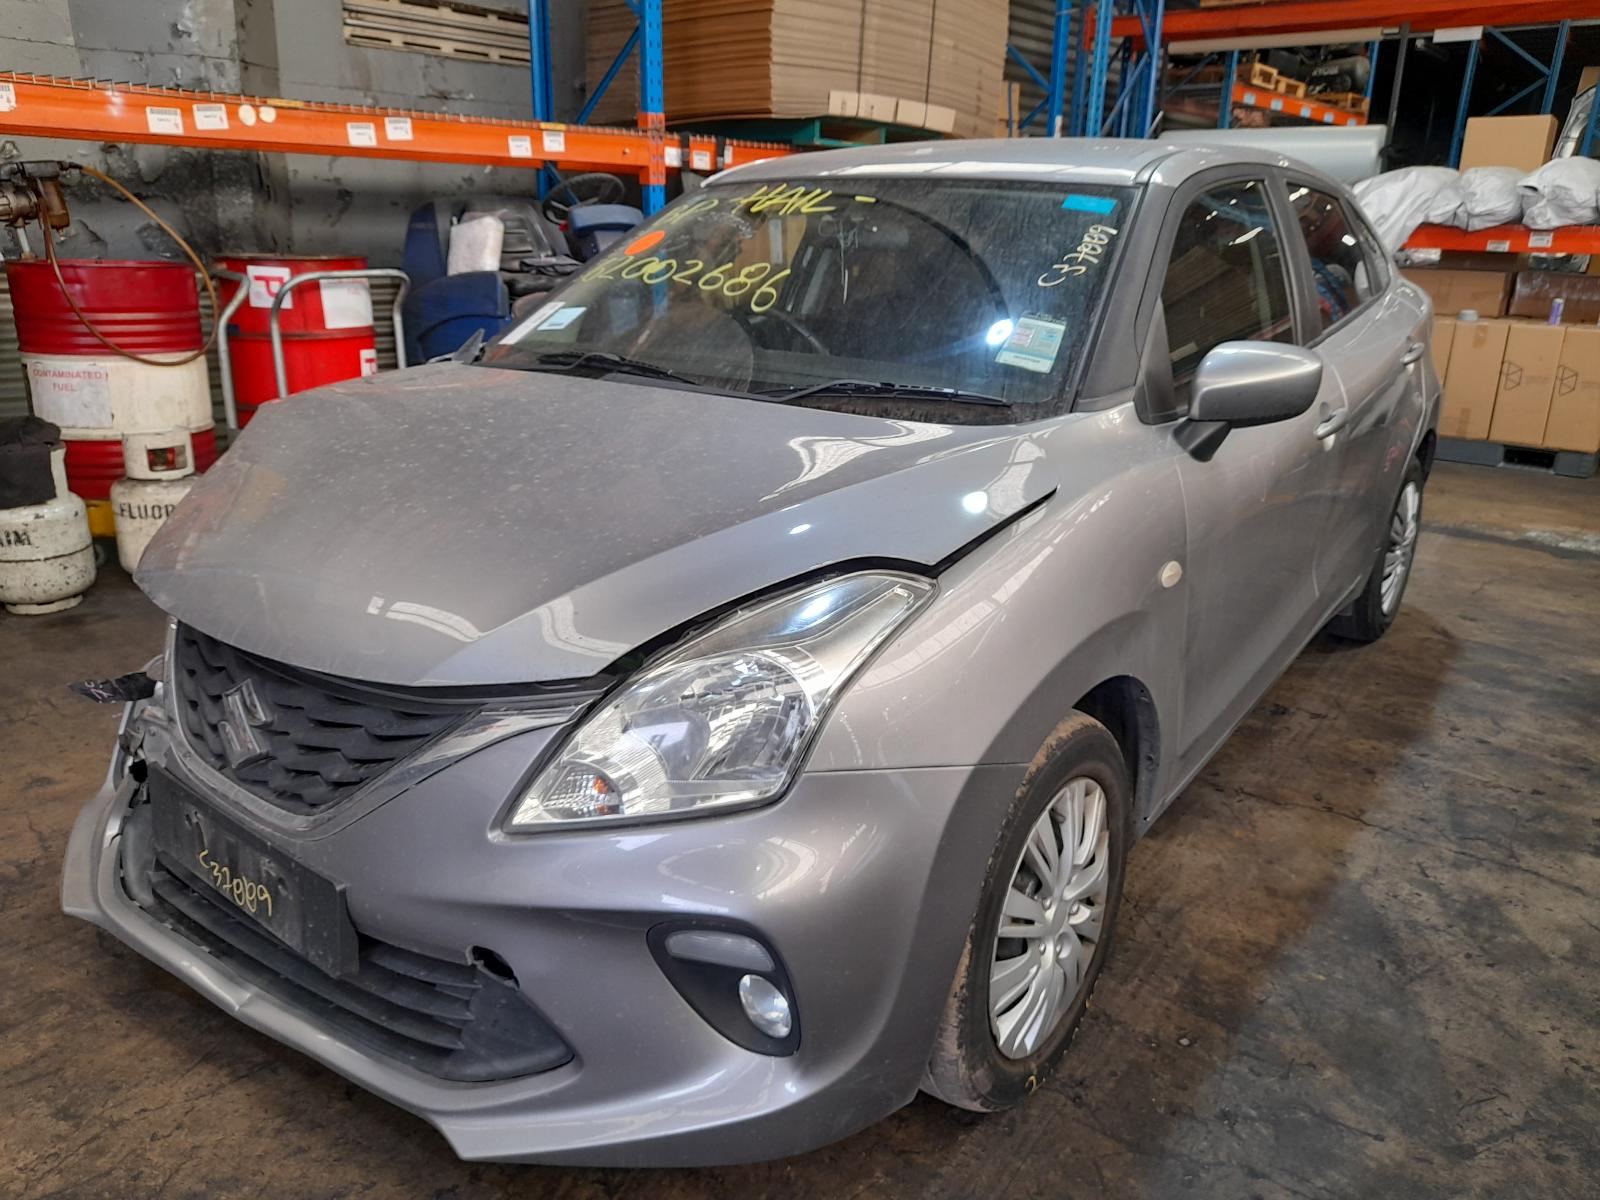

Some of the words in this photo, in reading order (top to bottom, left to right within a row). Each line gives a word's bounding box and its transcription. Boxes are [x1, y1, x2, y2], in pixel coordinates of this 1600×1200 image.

[33, 370, 102, 380] CONTAMINATED
[53, 383, 76, 392] FUEL
[199, 849, 272, 917] C37889
